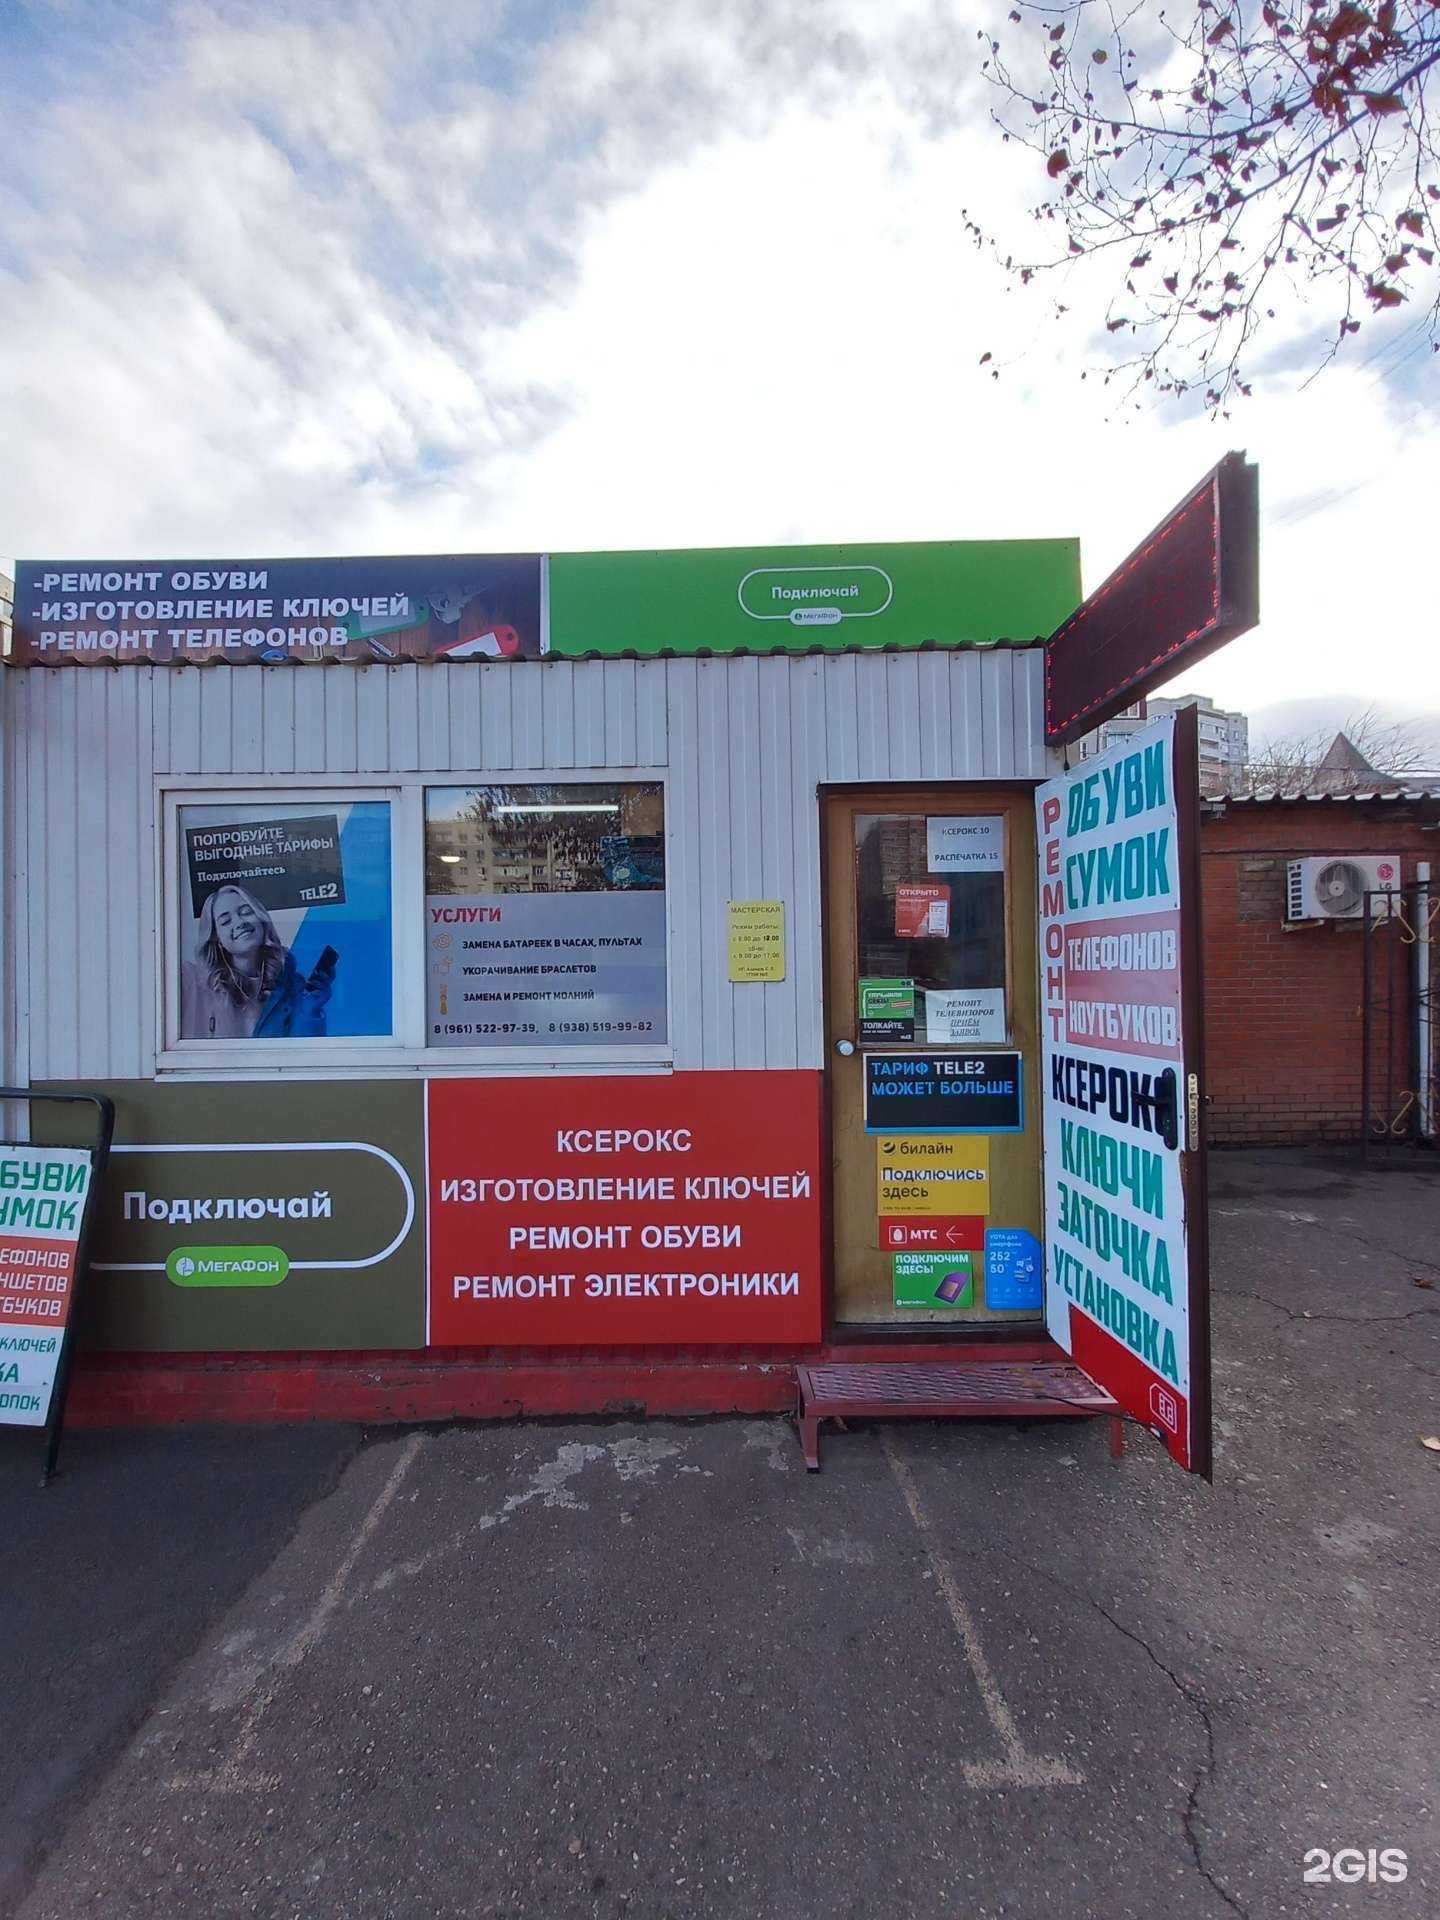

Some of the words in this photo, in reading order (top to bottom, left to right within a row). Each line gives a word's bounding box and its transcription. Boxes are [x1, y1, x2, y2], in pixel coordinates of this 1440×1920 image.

[171, 571, 267, 590] ОБУВИ
[771, 585, 859, 600] Подключай
[283, 592, 408, 617] КЛЮЧЕЙ
[168, 627, 348, 648] ТЕЛЕФОНОВ
[1066, 739, 1167, 838] ОБУВИ
[193, 827, 284, 847] ПОПРОБУЙТЕ
[942, 827, 978, 835] КСЕРОКС
[194, 843, 273, 862] ВЫГОДНЫЕ
[276, 837, 334, 853] ТАРИФЫ
[934, 853, 987, 861] РАСПЕЧАТКА
[989, 852, 998, 860] 15
[197, 866, 286, 882] Подключайтесь
[1066, 827, 1169, 910] СУМОК
[300, 883, 339, 900] TELE2
[899, 888, 939, 897] ОТКРЫТО
[432, 907, 501, 923] УСЛУГИ
[730, 906, 780, 914] МАСТЕРСКАЯ
[1042, 796, 1065, 1043] РЕМОНТ
[462, 940, 501, 949] ЗАМЕНА
[503, 939, 552, 948] БАТАРЕЕК
[554, 939, 561, 947] В
[599, 937, 643, 946] ПУЛЬТАХ
[1067, 929, 1176, 971] ТЕЛЕФОНОВ
[463, 966, 539, 975] УКОРАЧИВАНИЕ
[541, 965, 597, 974] БРАСЛЕТОВ
[463, 993, 502, 1001] ЗАМЕНА
[504, 993, 511, 1001] И
[512, 992, 551, 1001] РЕМОНТ
[553, 989, 595, 1000] МОЛНИЙ
[946, 1000, 982, 1008] РЕМОНТ
[936, 1009, 995, 1017] ТЕЛЕВИЗОРОВ
[434, 1026, 441, 1034] 8
[445, 1024, 472, 1034] (961)
[549, 1023, 556, 1032] 8
[559, 1022, 589, 1033] (938)
[593, 1021, 653, 1032] 519-99-82
[1069, 999, 1177, 1047] НОУТБУКОВ
[871, 1062, 929, 1075] ТАРИФ
[934, 1061, 985, 1075] TELE2
[872, 1081, 935, 1096] МОЖЕТ
[940, 1080, 1014, 1094] БОЛЬШЕ
[557, 1128, 692, 1152] КСЕРОКС
[900, 1142, 953, 1155] билайн
[882, 1167, 984, 1183] Подключись
[1061, 1118, 1164, 1220] КЛЮЧИ
[441, 1177, 675, 1202] ИЗГОТОВЛЕНИЕ
[685, 1171, 810, 1199] КЛЮЧЕЙ
[882, 1186, 929, 1200] здесь
[123, 1191, 332, 1224] Подключай
[510, 1226, 632, 1250] РЕМОНТ
[640, 1225, 742, 1248] ОБУВИ
[910, 1230, 938, 1240] МТС
[1057, 1181, 1174, 1306] ЗАТОЧКА
[895, 1254, 969, 1265] ПОДКЛЮЧИМ
[454, 1275, 576, 1299] РЕМОНТ
[585, 1272, 799, 1297] ЭЛЕКТРОНИКИ
[1054, 1244, 1179, 1385] УСТАНОВКА
